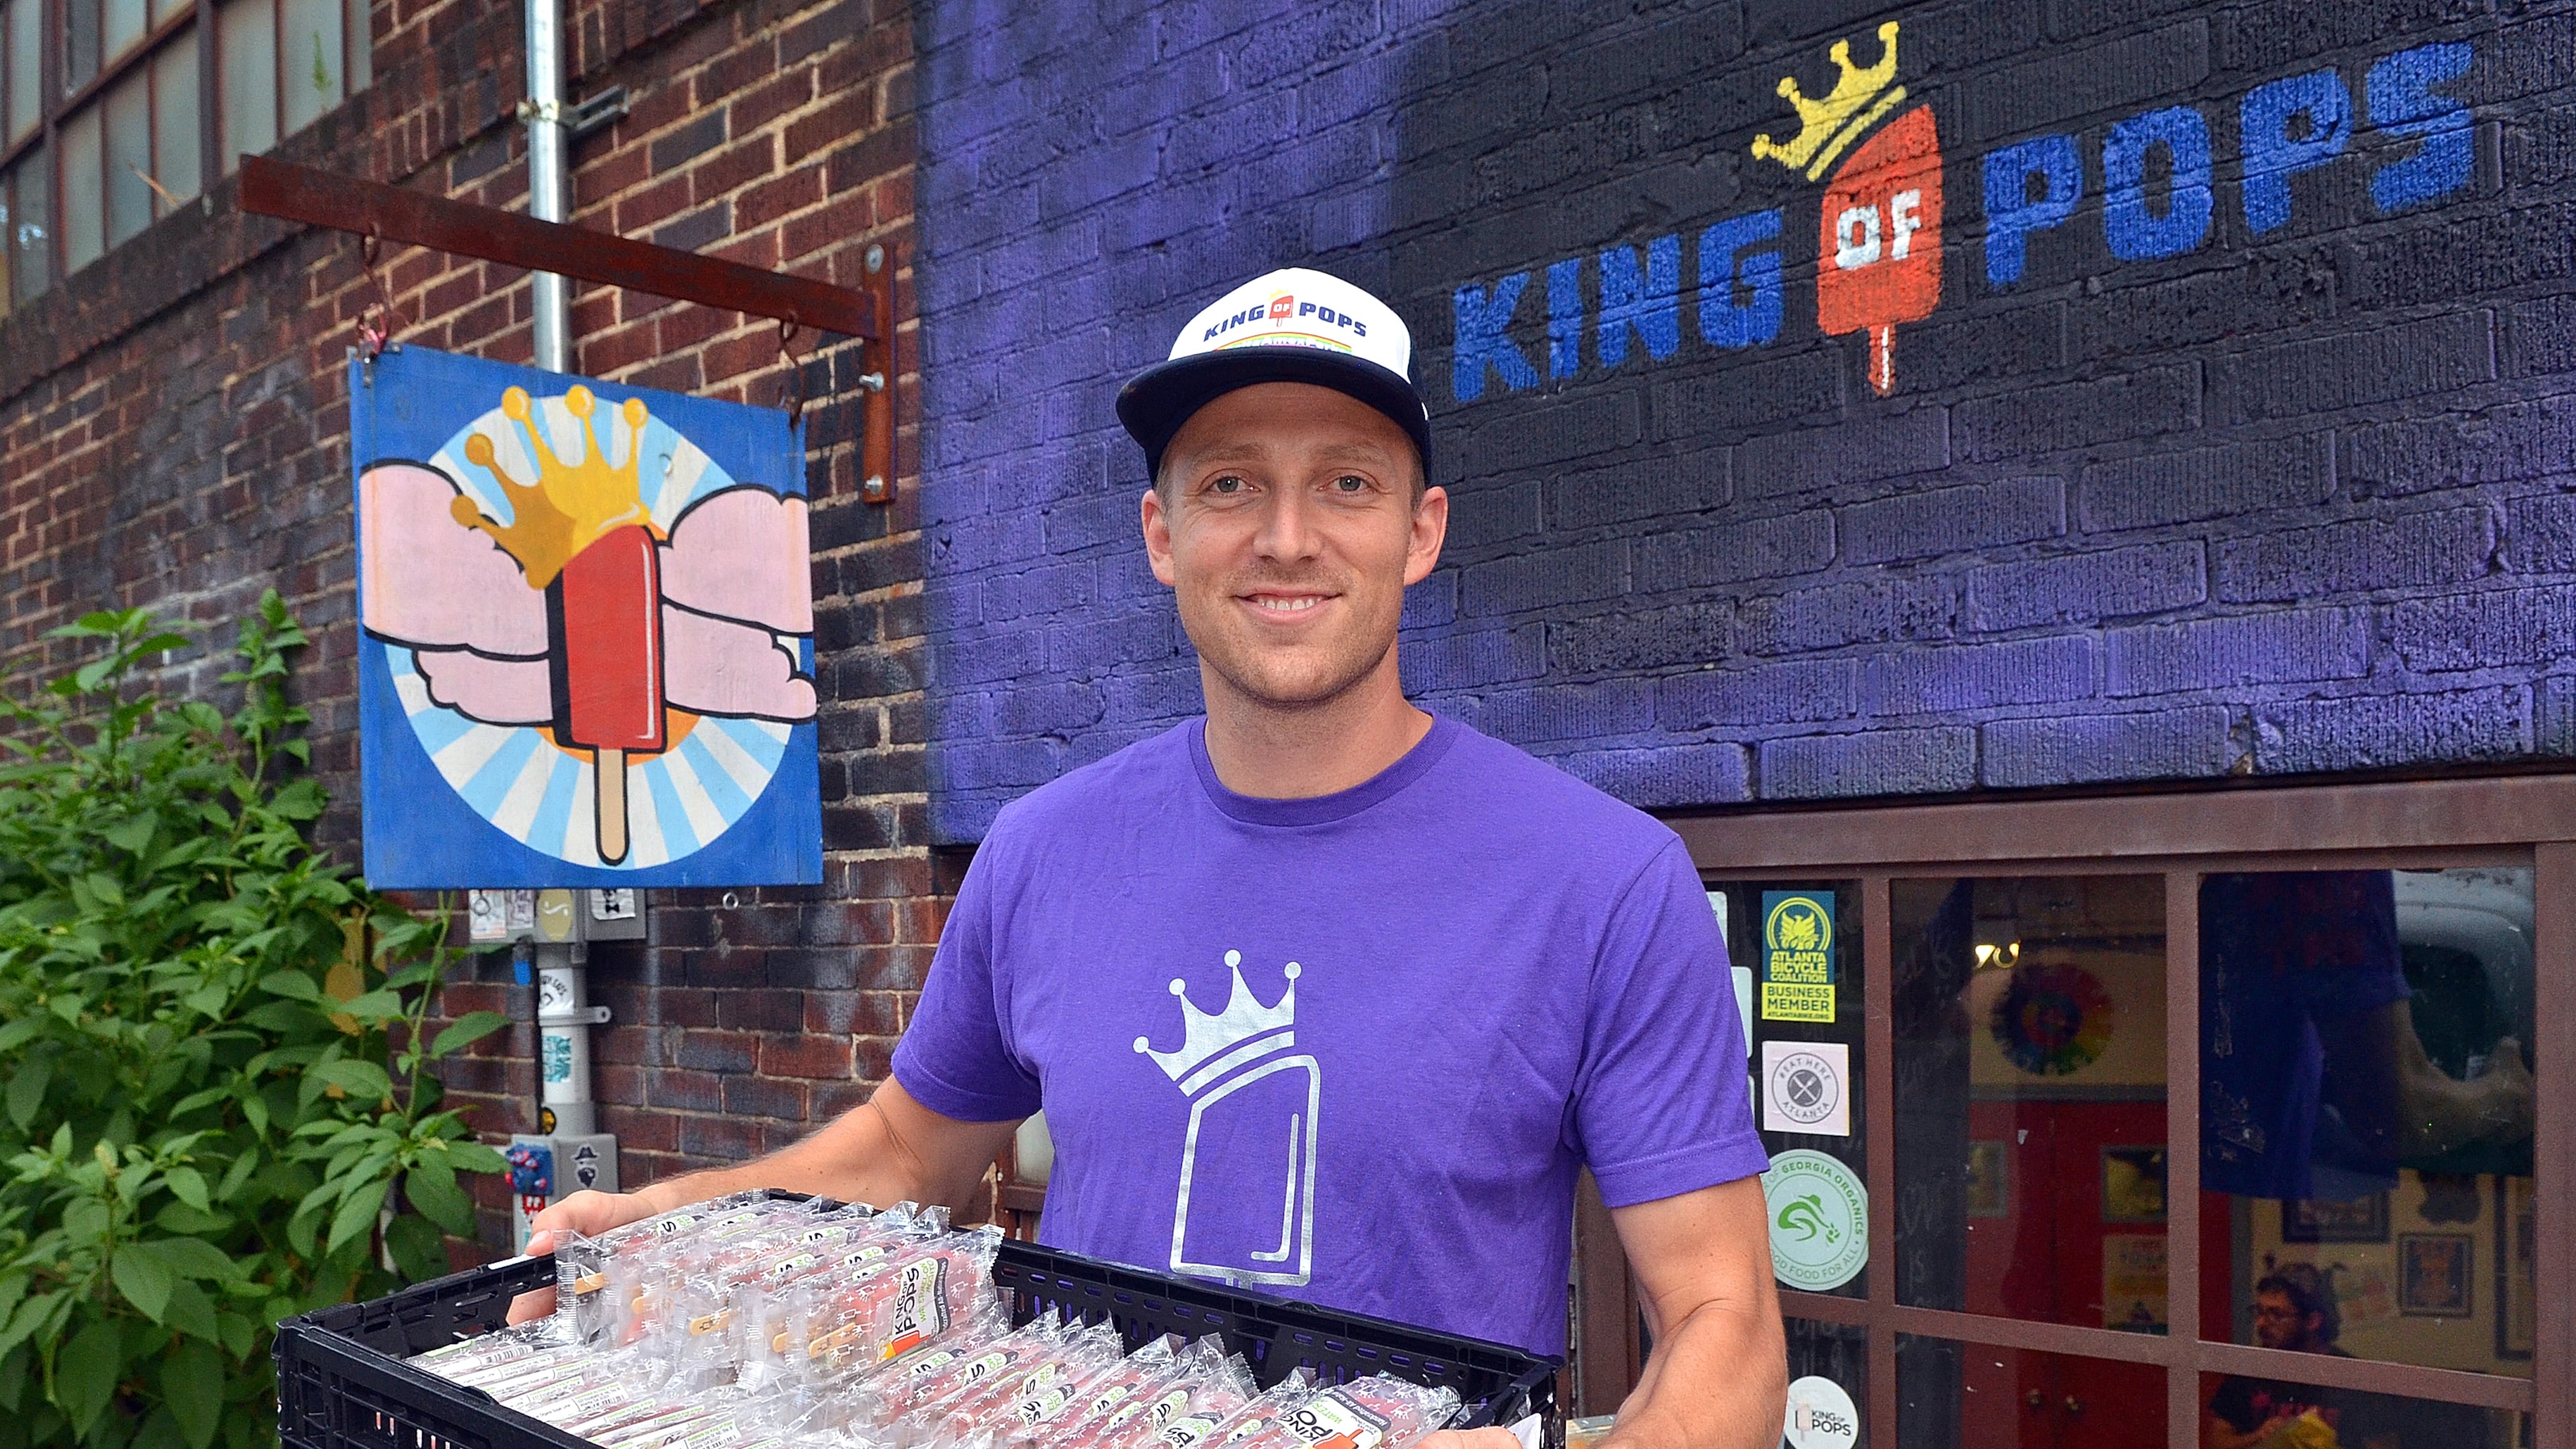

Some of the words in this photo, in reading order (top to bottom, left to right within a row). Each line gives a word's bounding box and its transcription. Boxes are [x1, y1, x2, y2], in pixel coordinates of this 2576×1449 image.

[1452, 208, 1784, 402] KING
[1835, 187, 1923, 272] OF
[1982, 41, 2474, 287] POPS
[1203, 305, 1265, 341] KING
[1273, 303, 1290, 313] OF
[1299, 302, 1366, 337] POPS
[1771, 951, 1827, 962] ATLANTA
[1771, 961, 1827, 973] BICYCLE
[1770, 973, 1827, 983] COALITION
[1768, 986, 1830, 998] BUSINESS
[1768, 998, 1829, 1012] MEMBER
[1782, 1102, 1829, 1118] ATLANTA
[1782, 1161, 1833, 1177] GEORGIA
[1834, 1175, 1864, 1236] ORGANICS
[1789, 1266, 1819, 1279] FOOD
[1823, 1263, 1843, 1276] FOR
[1844, 1249, 1858, 1264] ALL
[904, 1268, 919, 1331] POPS
[1812, 1409, 1836, 1421] KING
[1812, 1419, 1851, 1436] POPS
